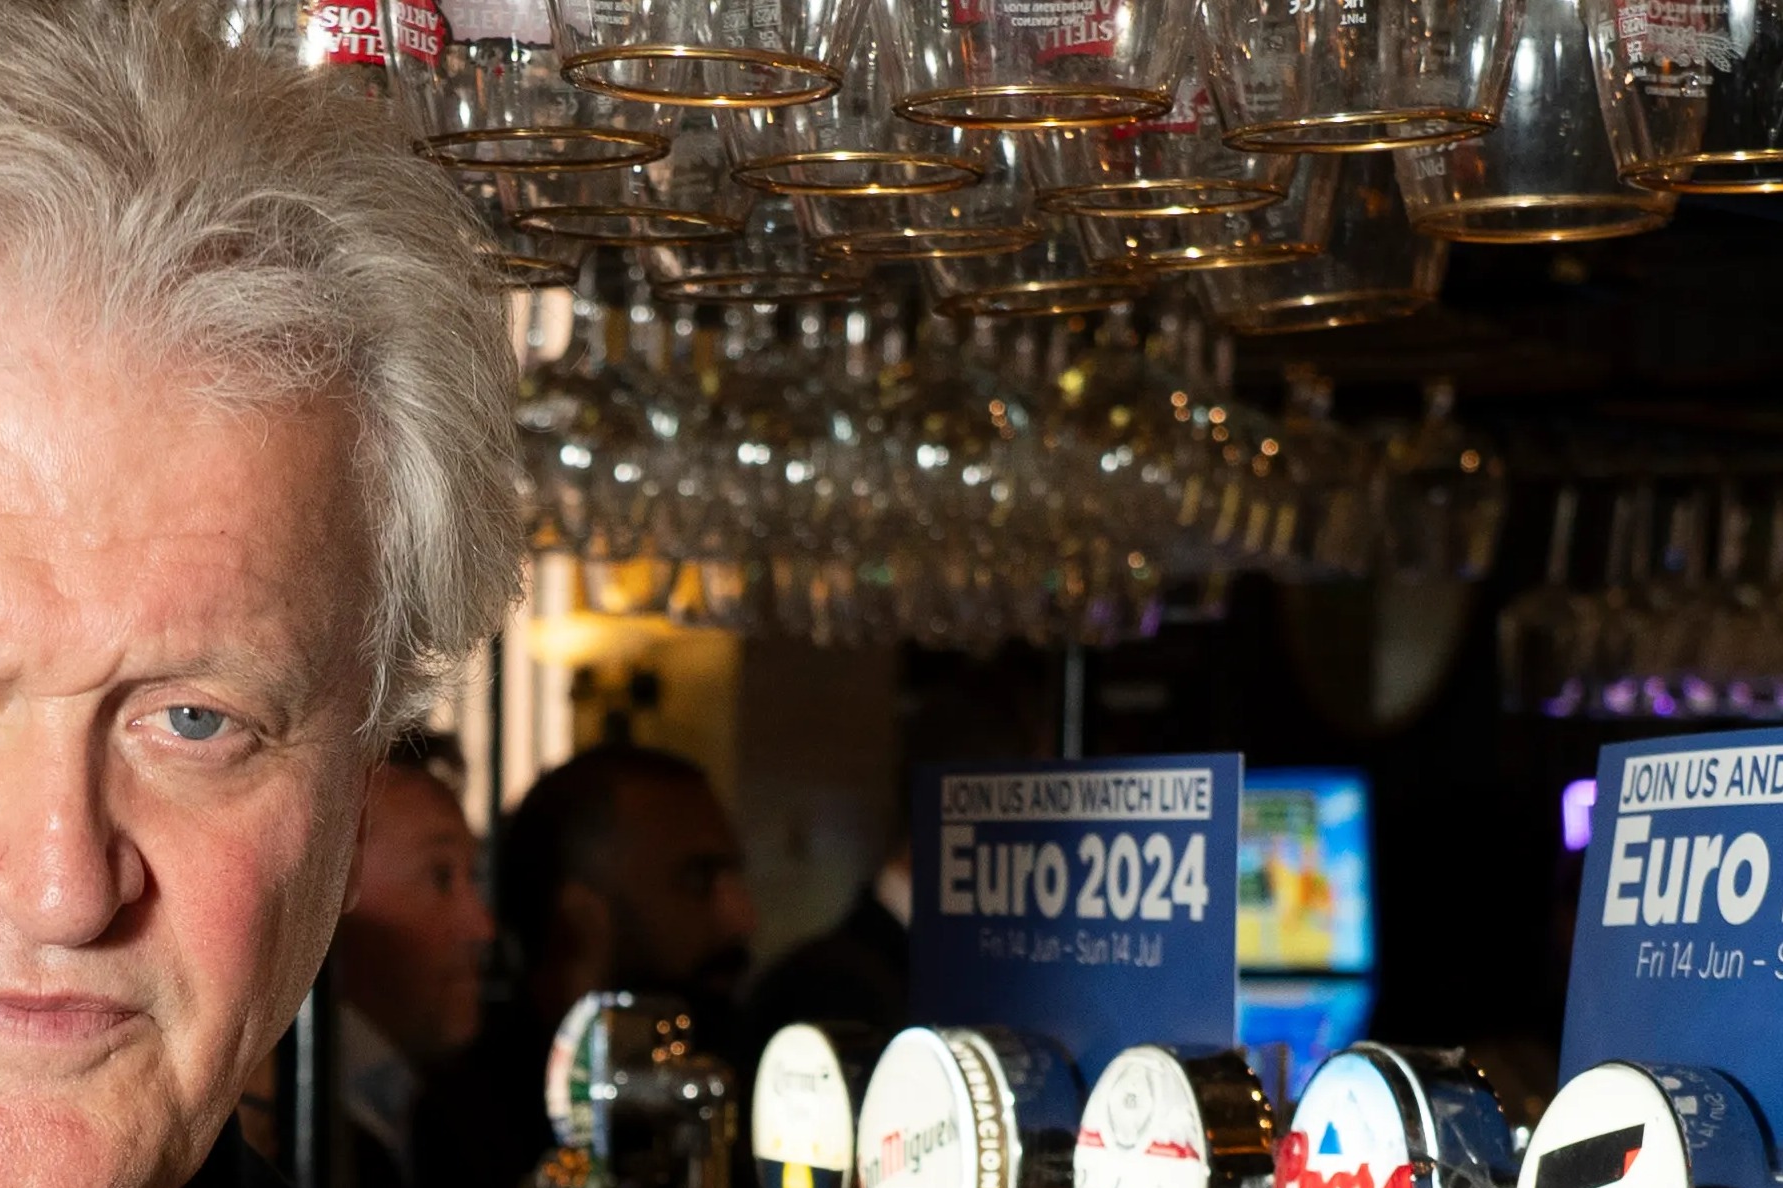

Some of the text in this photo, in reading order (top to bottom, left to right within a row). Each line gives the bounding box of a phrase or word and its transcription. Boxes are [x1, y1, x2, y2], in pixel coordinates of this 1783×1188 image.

[397, 2, 439, 31] ARTO
[1340, 13, 1367, 26] PINT
[397, 23, 439, 56] STELL
[998, 778, 1024, 812] US
[1030, 777, 1074, 812] AND
[1078, 777, 1153, 812] WATCH
[1158, 776, 1208, 812] LIVE
[1622, 761, 1679, 805] JOIN
[1685, 757, 1720, 800] US
[939, 825, 1209, 922] Euro 2024
[1602, 814, 1770, 926] Euro
[1076, 929, 1111, 965] Sun
[1112, 931, 1130, 965] 14
[1133, 931, 1163, 967] Jul
[1635, 941, 1665, 979] Fri
[1670, 941, 1695, 979] 14
[1698, 941, 1745, 979] Jun
